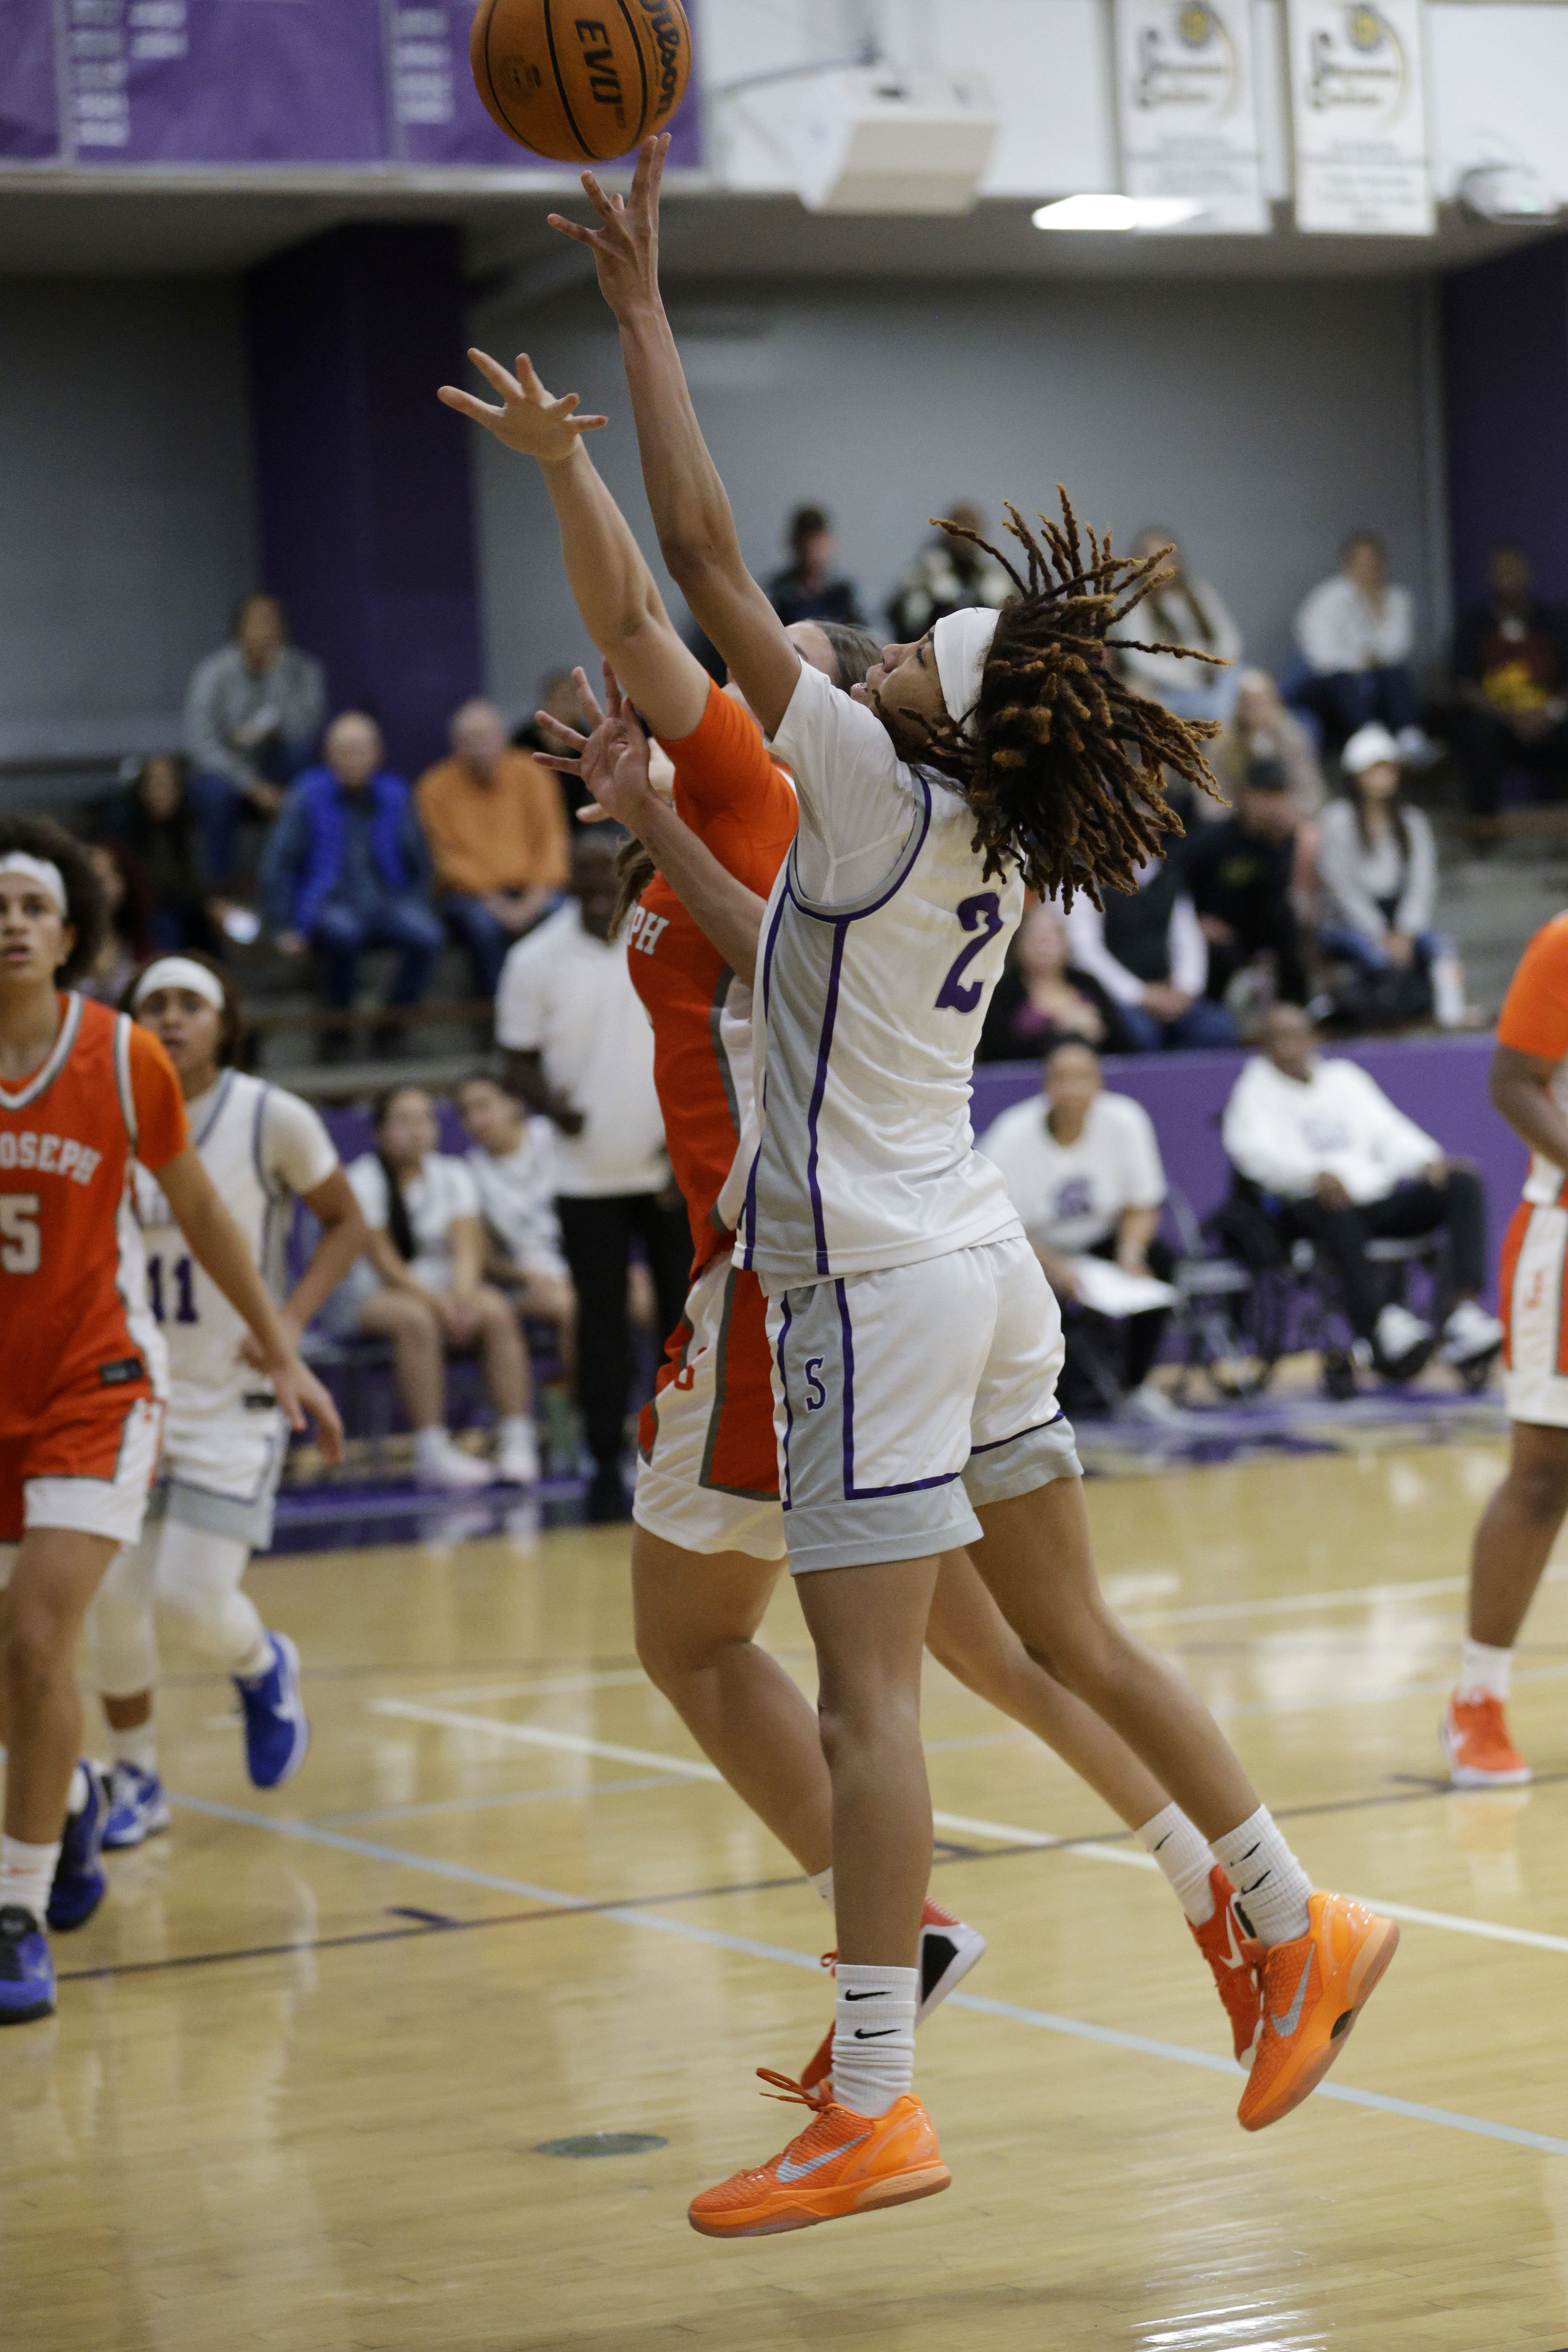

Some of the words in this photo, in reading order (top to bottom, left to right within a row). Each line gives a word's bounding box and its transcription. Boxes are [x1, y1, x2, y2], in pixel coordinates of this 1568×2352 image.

[575, 20, 622, 103] EVO
[627, 902, 671, 956] PH
[933, 890, 1004, 1014] 2
[0, 1131, 103, 1186] OSEPH
[0, 1193, 42, 1275] 5
[147, 1256, 199, 1323] 11
[805, 1356, 826, 1412] S
